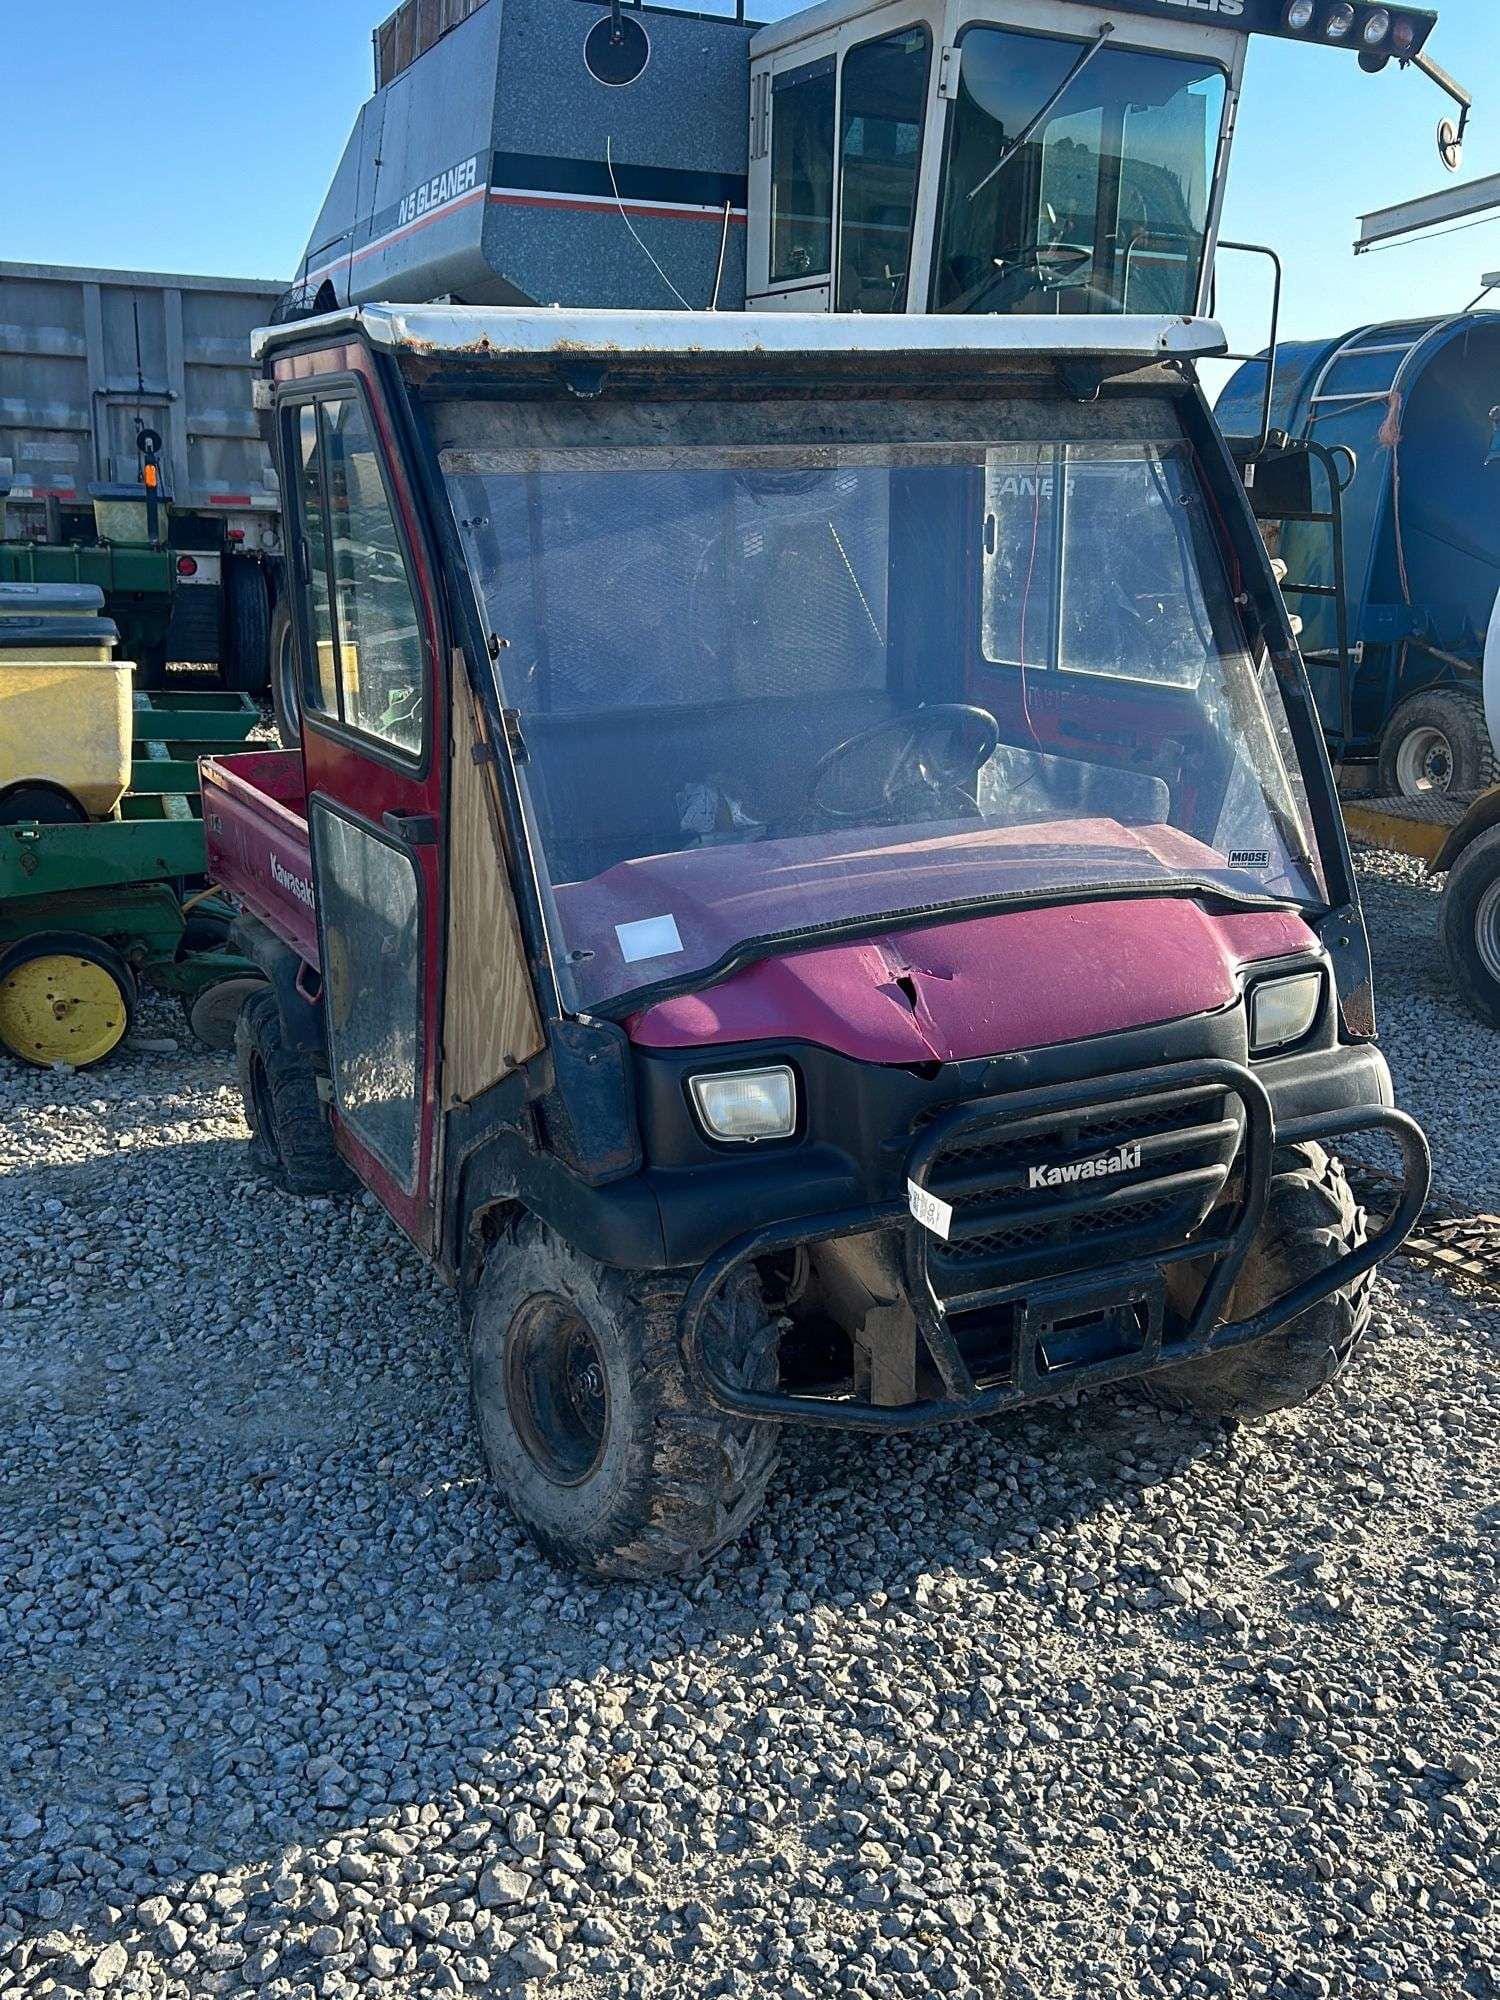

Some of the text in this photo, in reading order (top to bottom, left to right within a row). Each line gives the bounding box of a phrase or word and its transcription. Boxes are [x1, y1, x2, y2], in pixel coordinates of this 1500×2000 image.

[398, 156, 477, 225] N5 GLEANER
[268, 850, 316, 910] Kawasaki
[1231, 852, 1268, 862] MOOSE
[1028, 1144, 1141, 1188] Kawasaki
